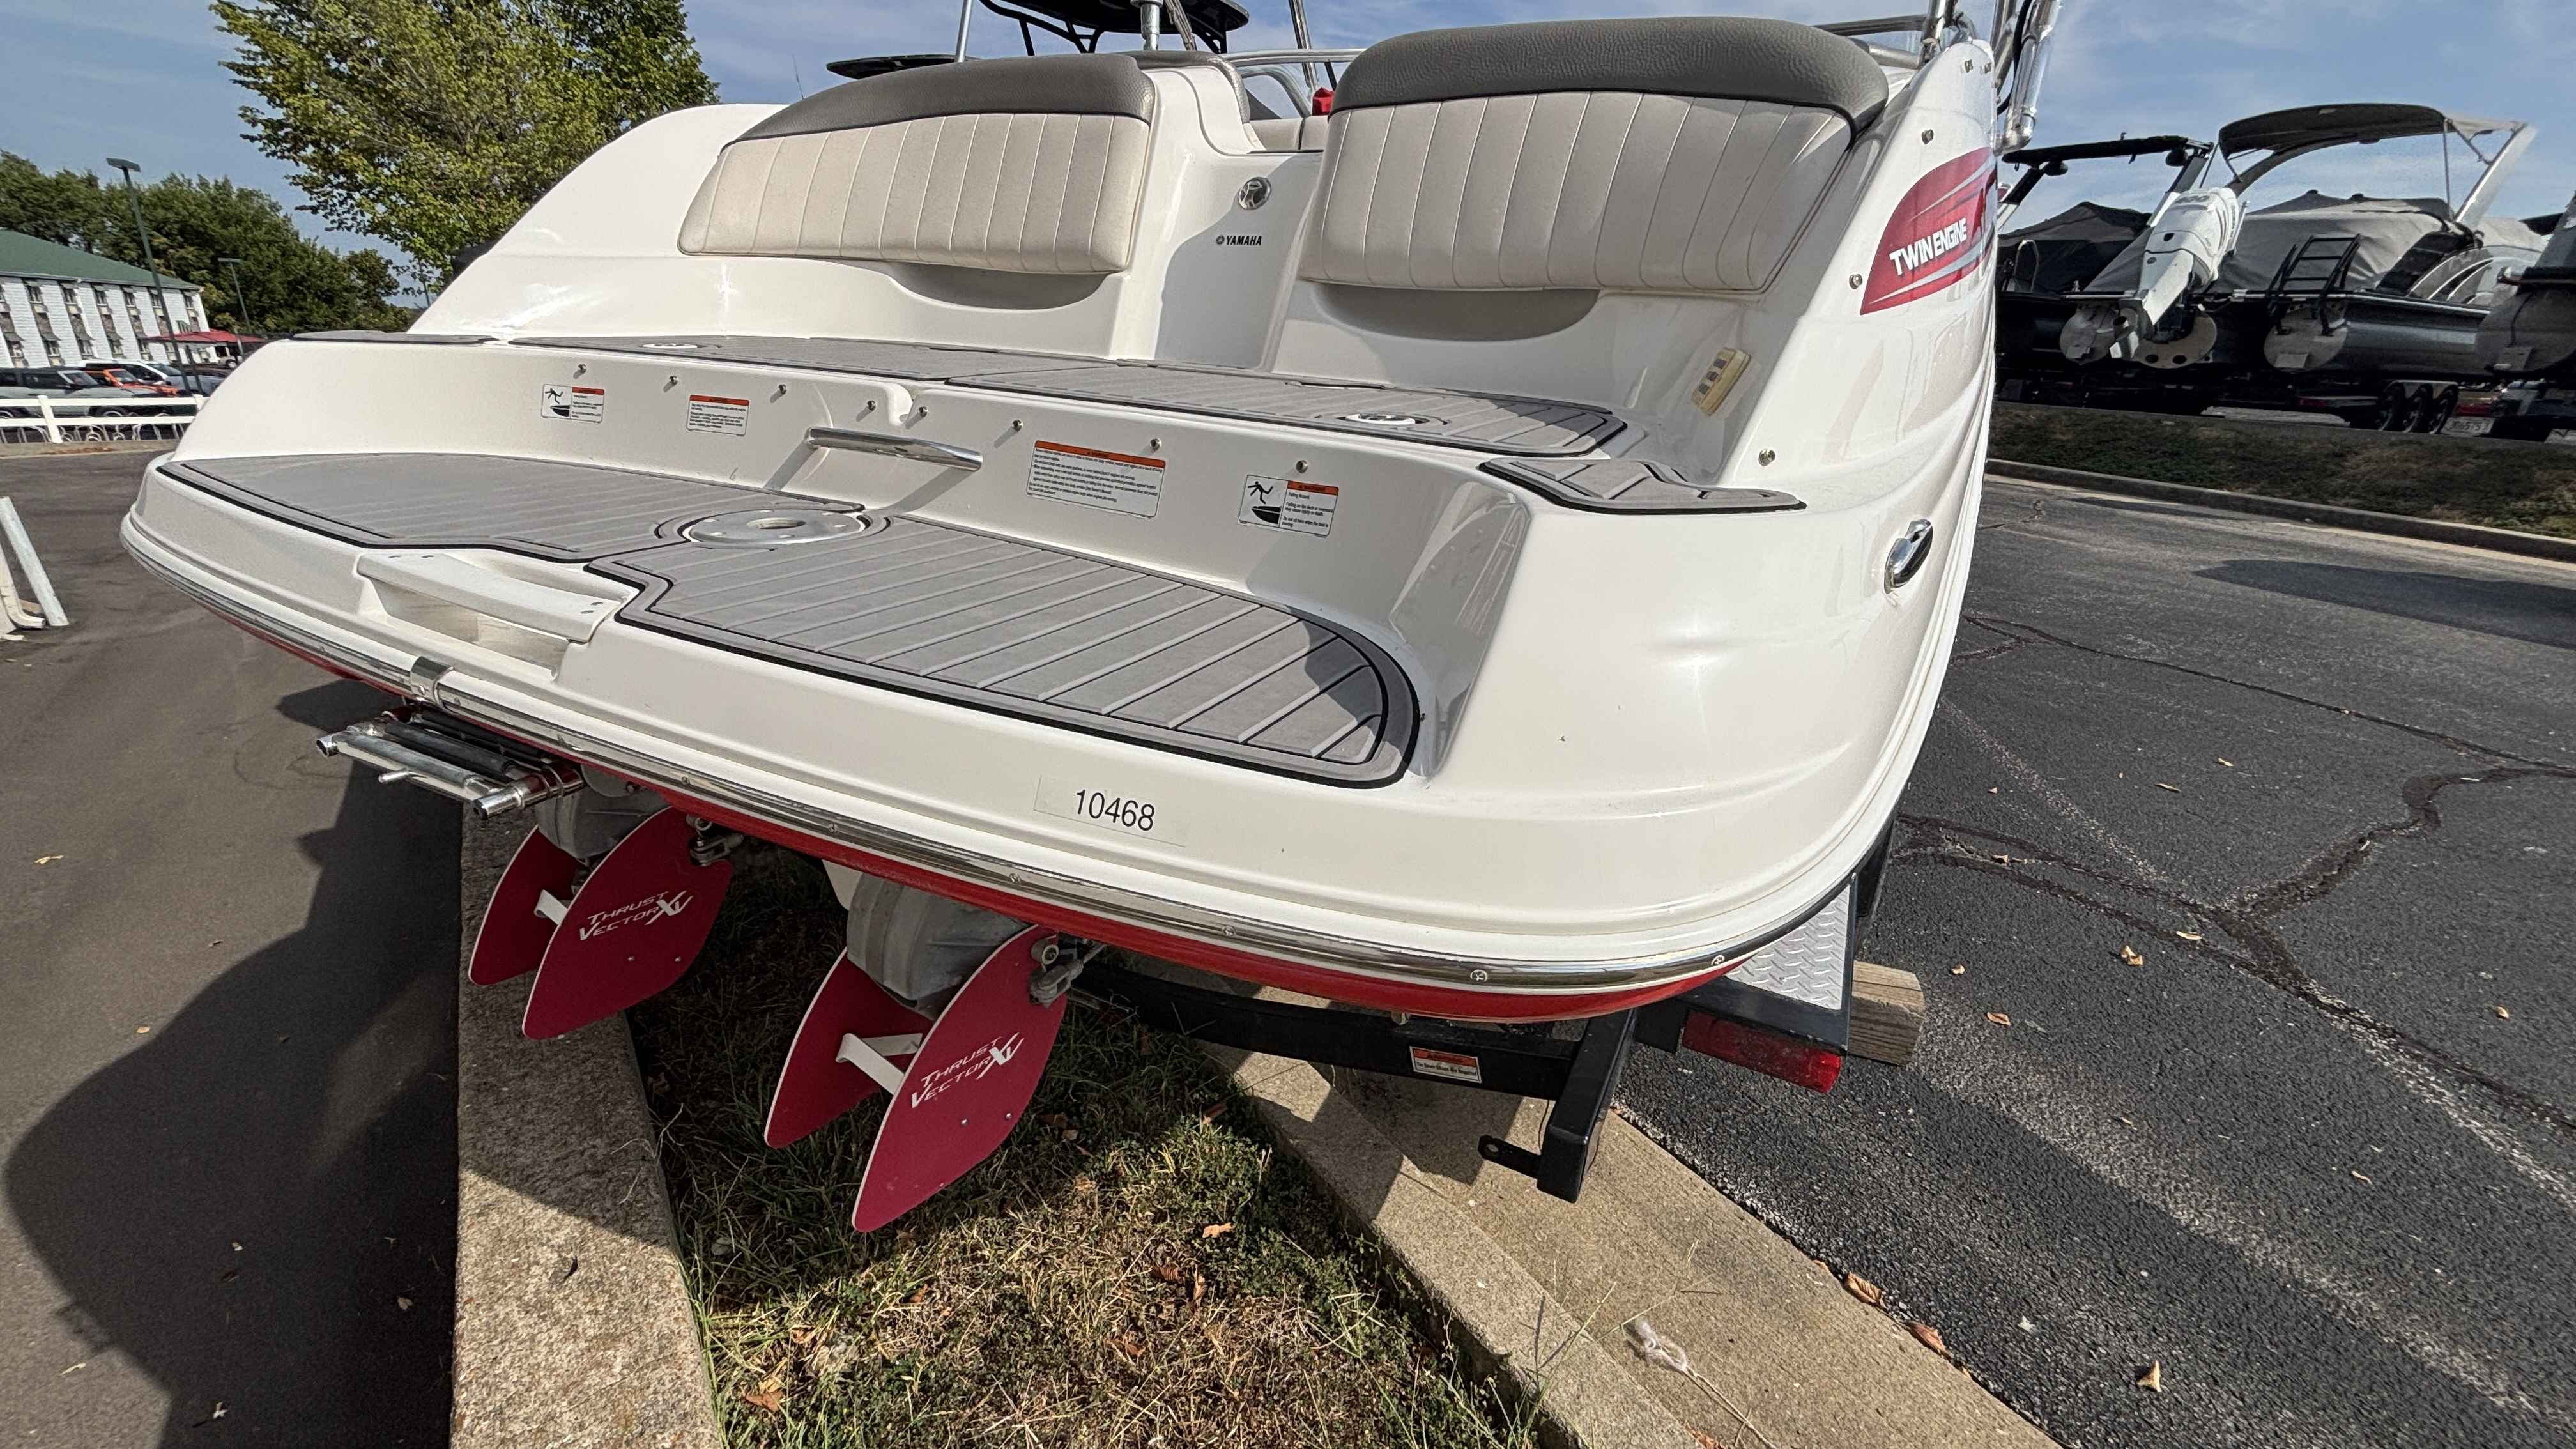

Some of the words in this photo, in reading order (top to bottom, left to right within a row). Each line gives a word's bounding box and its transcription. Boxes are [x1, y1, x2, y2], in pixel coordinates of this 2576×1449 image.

[1226, 235, 1262, 246] YAMAHA
[1889, 235, 1933, 277] TWIN
[1933, 217, 1968, 256] ENGINE
[1076, 788, 1156, 831] 10468
[587, 891, 669, 926] THRUST
[920, 1036, 1002, 1088] THRUST
